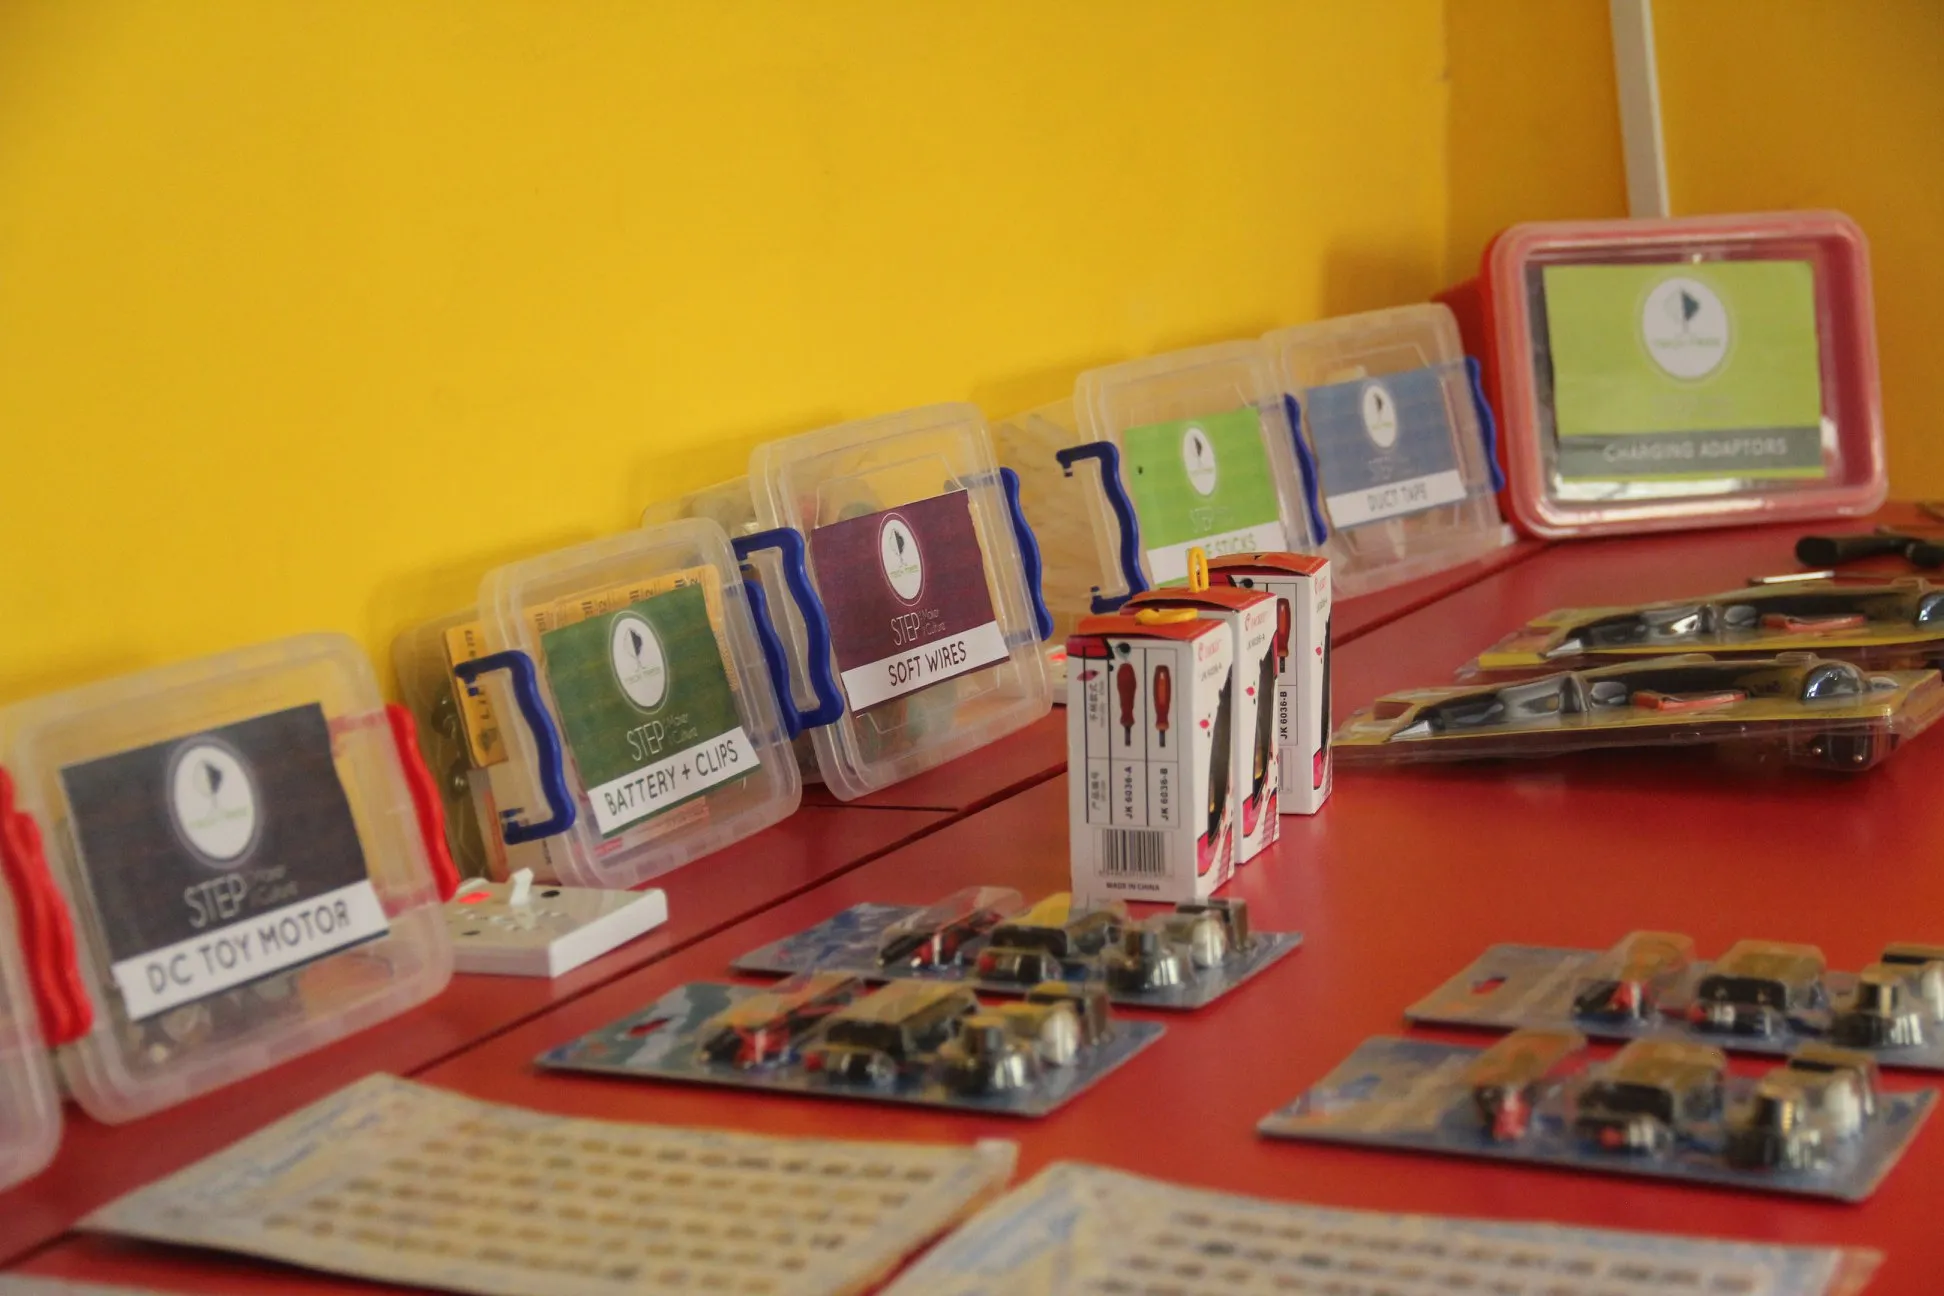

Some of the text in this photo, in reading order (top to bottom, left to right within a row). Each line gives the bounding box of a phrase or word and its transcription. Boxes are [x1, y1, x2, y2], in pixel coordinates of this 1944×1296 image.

[1602, 440, 1695, 462] CHARGING
[890, 612, 920, 646] STEP
[888, 640, 967, 687] SOFT WIRES
[1280, 691, 1289, 740] JK 6036-B
[626, 720, 665, 762] STEP
[604, 764, 677, 816] BATTERY
[695, 739, 739, 778] CLIPS
[182, 873, 248, 929] STEP
[145, 899, 351, 996] DC TOY MOTOR
